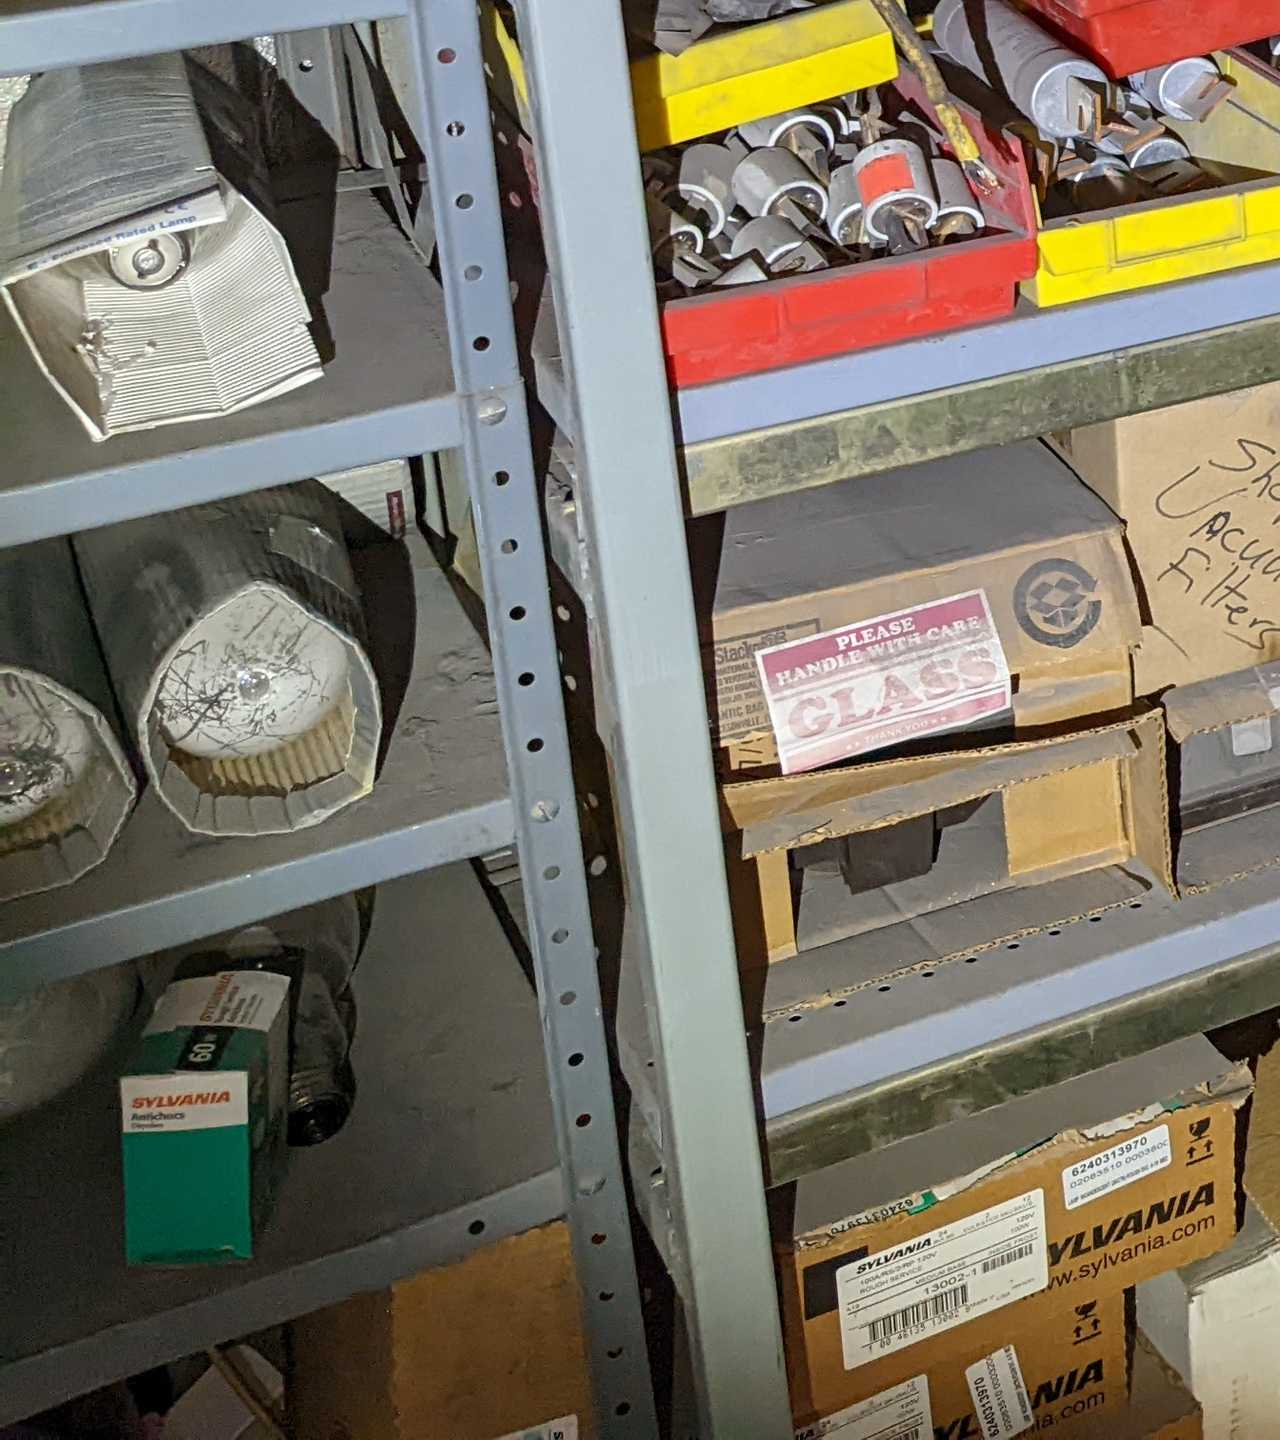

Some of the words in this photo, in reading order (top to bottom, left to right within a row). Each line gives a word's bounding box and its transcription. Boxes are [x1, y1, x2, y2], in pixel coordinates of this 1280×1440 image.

[115, 225, 156, 241] Rated
[159, 214, 197, 229] Lamp
[775, 651, 864, 687] HANDLE
[865, 633, 922, 662] WITH
[927, 615, 981, 642] CARE
[835, 617, 916, 651] PLEASE
[788, 646, 998, 740] GLASS
[864, 727, 901, 746] THANK
[903, 718, 930, 735] YOU
[132, 1091, 230, 1109] SYLVANIA
[1072, 1137, 1147, 1177] 6240313970
[1048, 1181, 1214, 1267] YLVANIA
[856, 1238, 932, 1275] SYLVANIA
[859, 1277, 889, 1295] ROUGH
[890, 1266, 923, 1284] SERVICE
[923, 1268, 978, 1295] 13002-1
